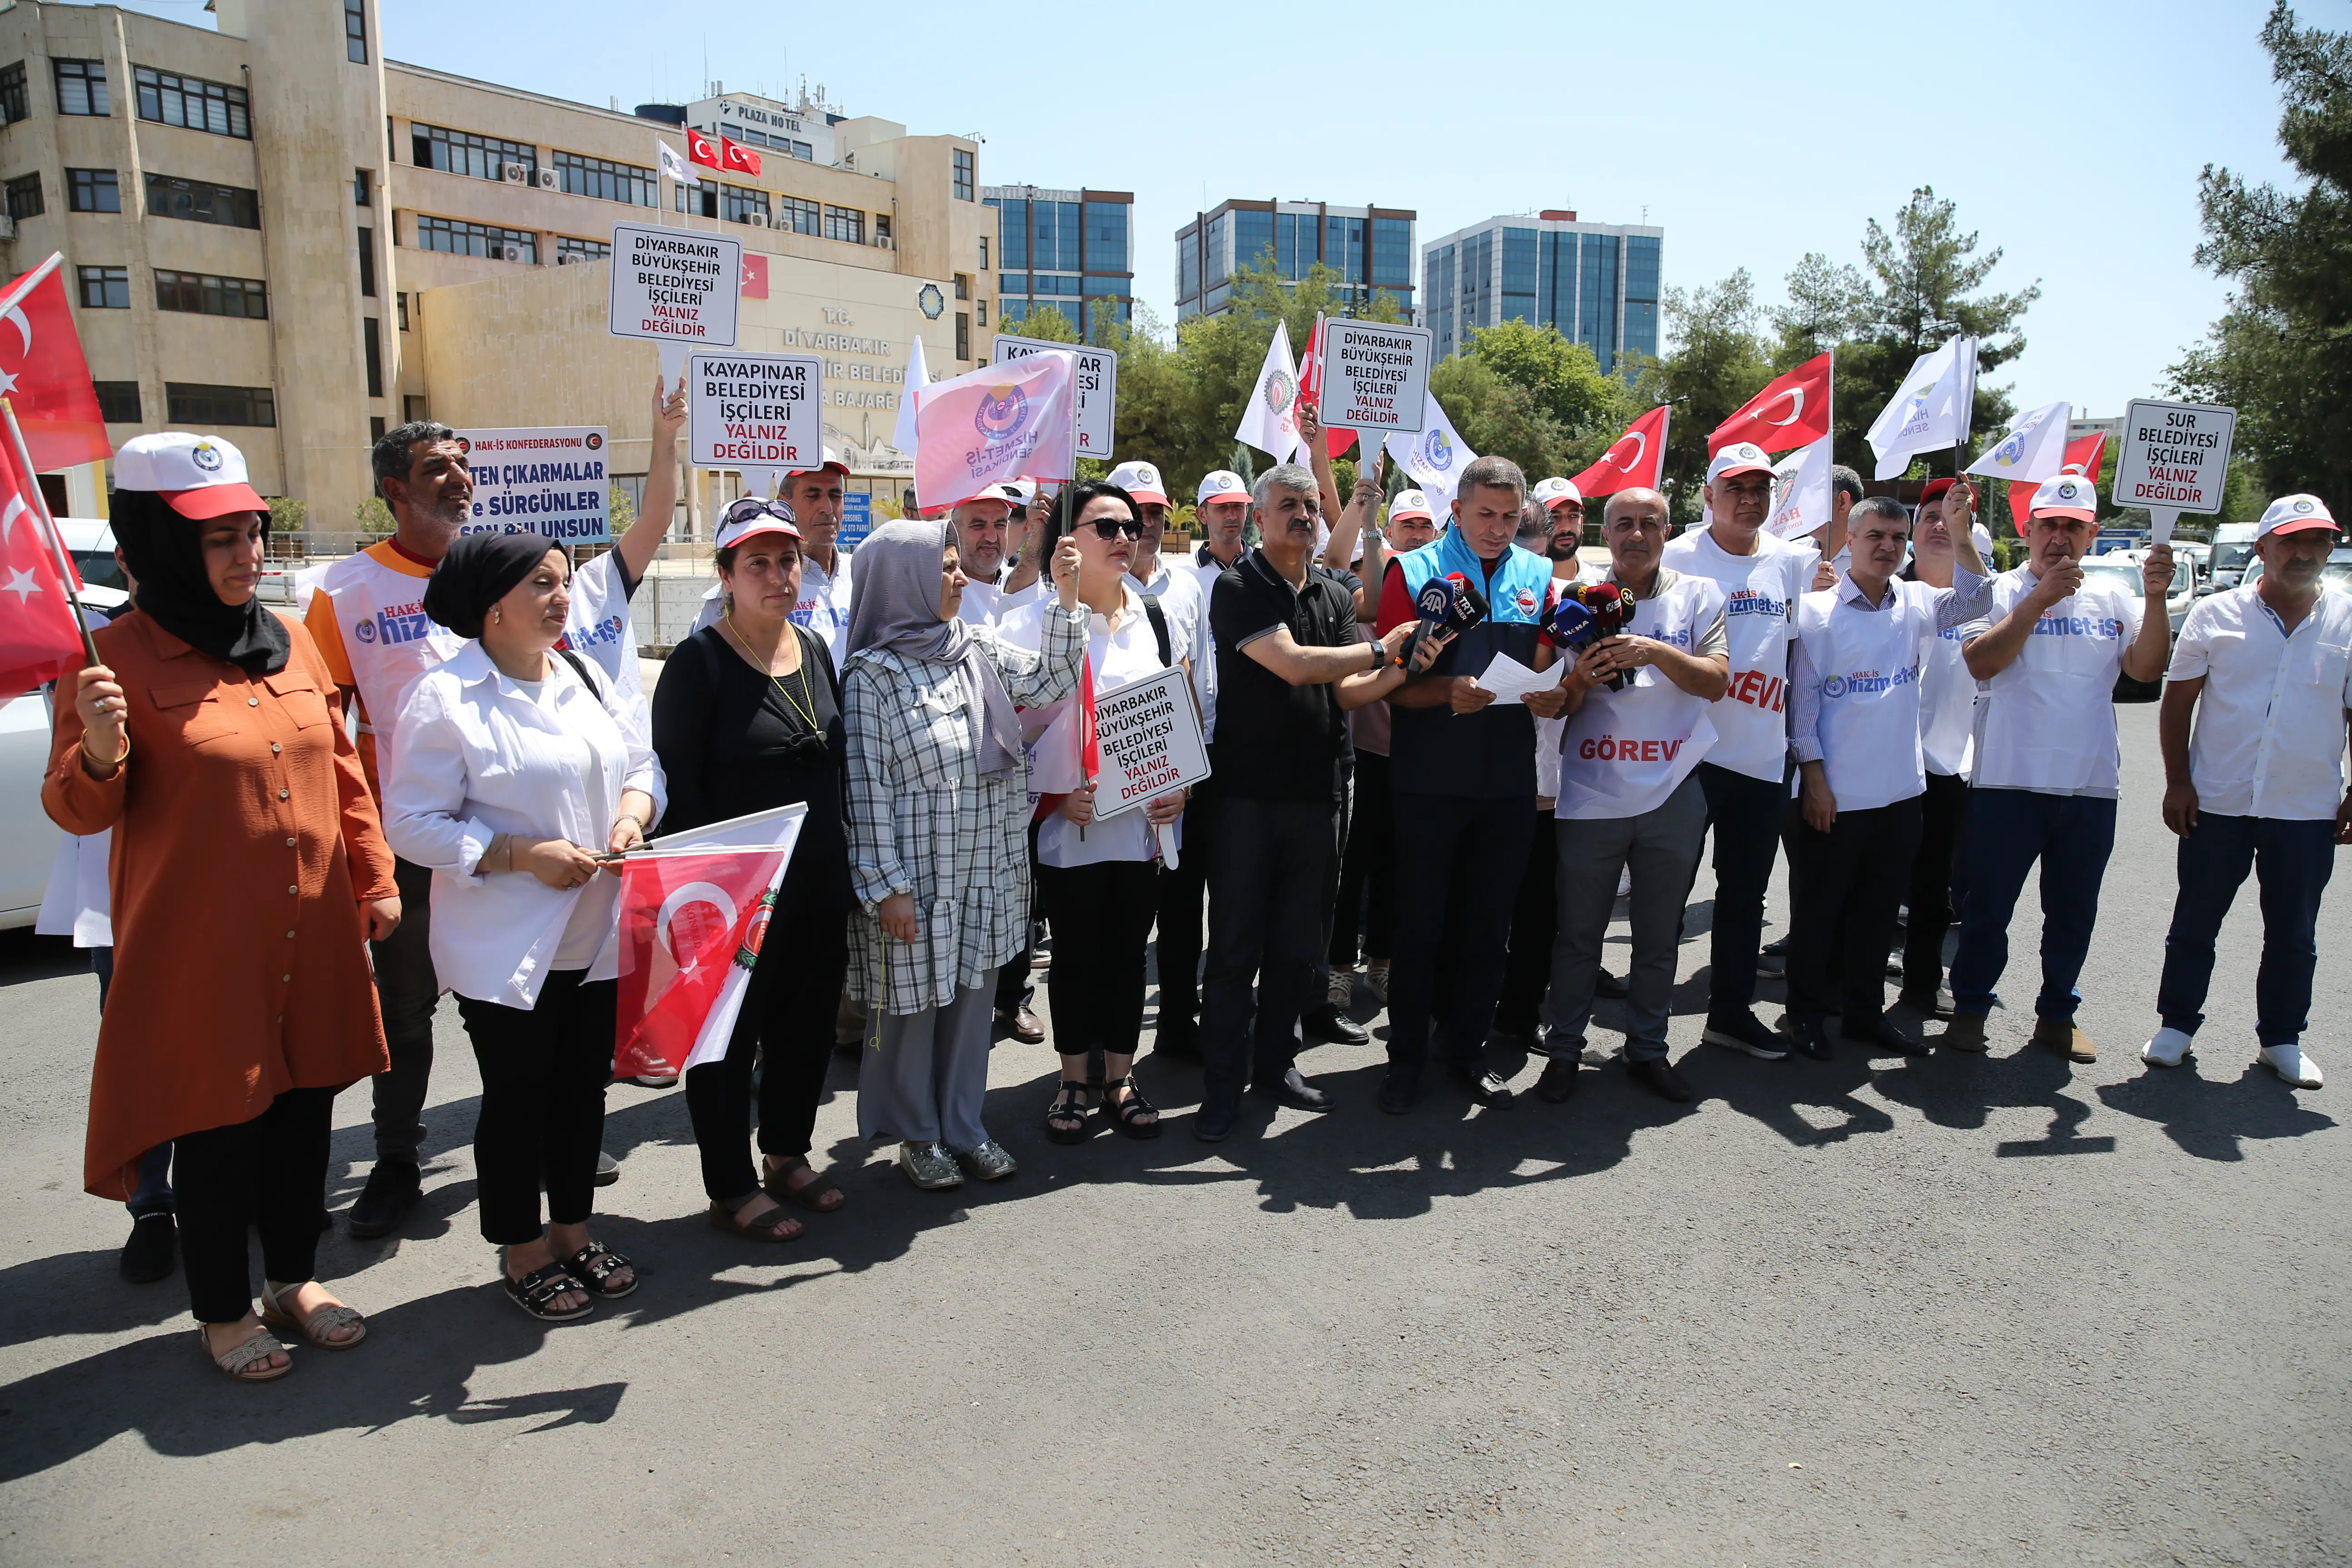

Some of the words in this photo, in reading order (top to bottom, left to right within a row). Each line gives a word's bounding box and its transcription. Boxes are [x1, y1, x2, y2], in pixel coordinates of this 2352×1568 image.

[739, 106, 767, 124] PLAZA
[771, 114, 801, 132] HOTEL
[1034, 189, 1079, 201] OFFICE
[635, 235, 718, 258] DİYARBAKIR
[632, 254, 720, 276] BÜYÜKŞEHİR
[638, 273, 713, 292] BELEDİYESİ
[648, 289, 702, 305] İŞÇİLERİ
[652, 304, 699, 320] YALNIZ
[822, 307, 854, 326] T.C.
[642, 318, 706, 337] DEĞİLDİR
[784, 327, 891, 356] DİYARBAKIR
[1344, 331, 1412, 351] DİYARBAKIR
[1341, 347, 1413, 366] BÜYÜKŞEHİR
[703, 362, 806, 381] KAYAPINAR
[1346, 365, 1407, 382] BELEDİYESİ
[706, 381, 804, 400] BELEDİYESİ
[1353, 377, 1397, 395] İŞÇİLERİ
[720, 401, 790, 422] İŞÇİLERİ
[1355, 395, 1393, 409] YALNIZ
[1346, 408, 1398, 424] DEĞİLDİR
[2166, 412, 2196, 428] SUR
[725, 424, 787, 440] YALNIZ
[2138, 427, 2219, 449] BELEDİYESİ
[475, 438, 504, 451] HAK-İŞ
[506, 438, 582, 449] KONFEDERASYONU
[713, 441, 797, 461] DEĞİLDİR
[2147, 445, 2203, 466] İŞÇİLERİ
[469, 466, 499, 485] TEN
[503, 461, 603, 489] ÇIKARMALAR
[2148, 466, 2198, 484] YALNIZ
[473, 502, 483, 516] e
[489, 488, 600, 516] SÜRGÜNLER
[2135, 482, 2202, 503] DEĞİLDİR
[384, 599, 425, 618] HAK-İ
[1420, 594, 1442, 614] AA
[1453, 602, 1466, 620] HABER
[1459, 596, 1475, 614] TRT
[1547, 622, 1558, 633] TR
[1095, 686, 1167, 723] DİYARBAKIR
[1096, 701, 1174, 740] BÜYÜKŞEHİR
[1103, 717, 1173, 756] BELEDİYESİ
[1117, 737, 1168, 769] İŞÇİLERİ
[1580, 735, 1682, 761] GÖREV
[1124, 755, 1169, 781] YALNIZ
[1121, 767, 1180, 800] DEĞİLDİR
